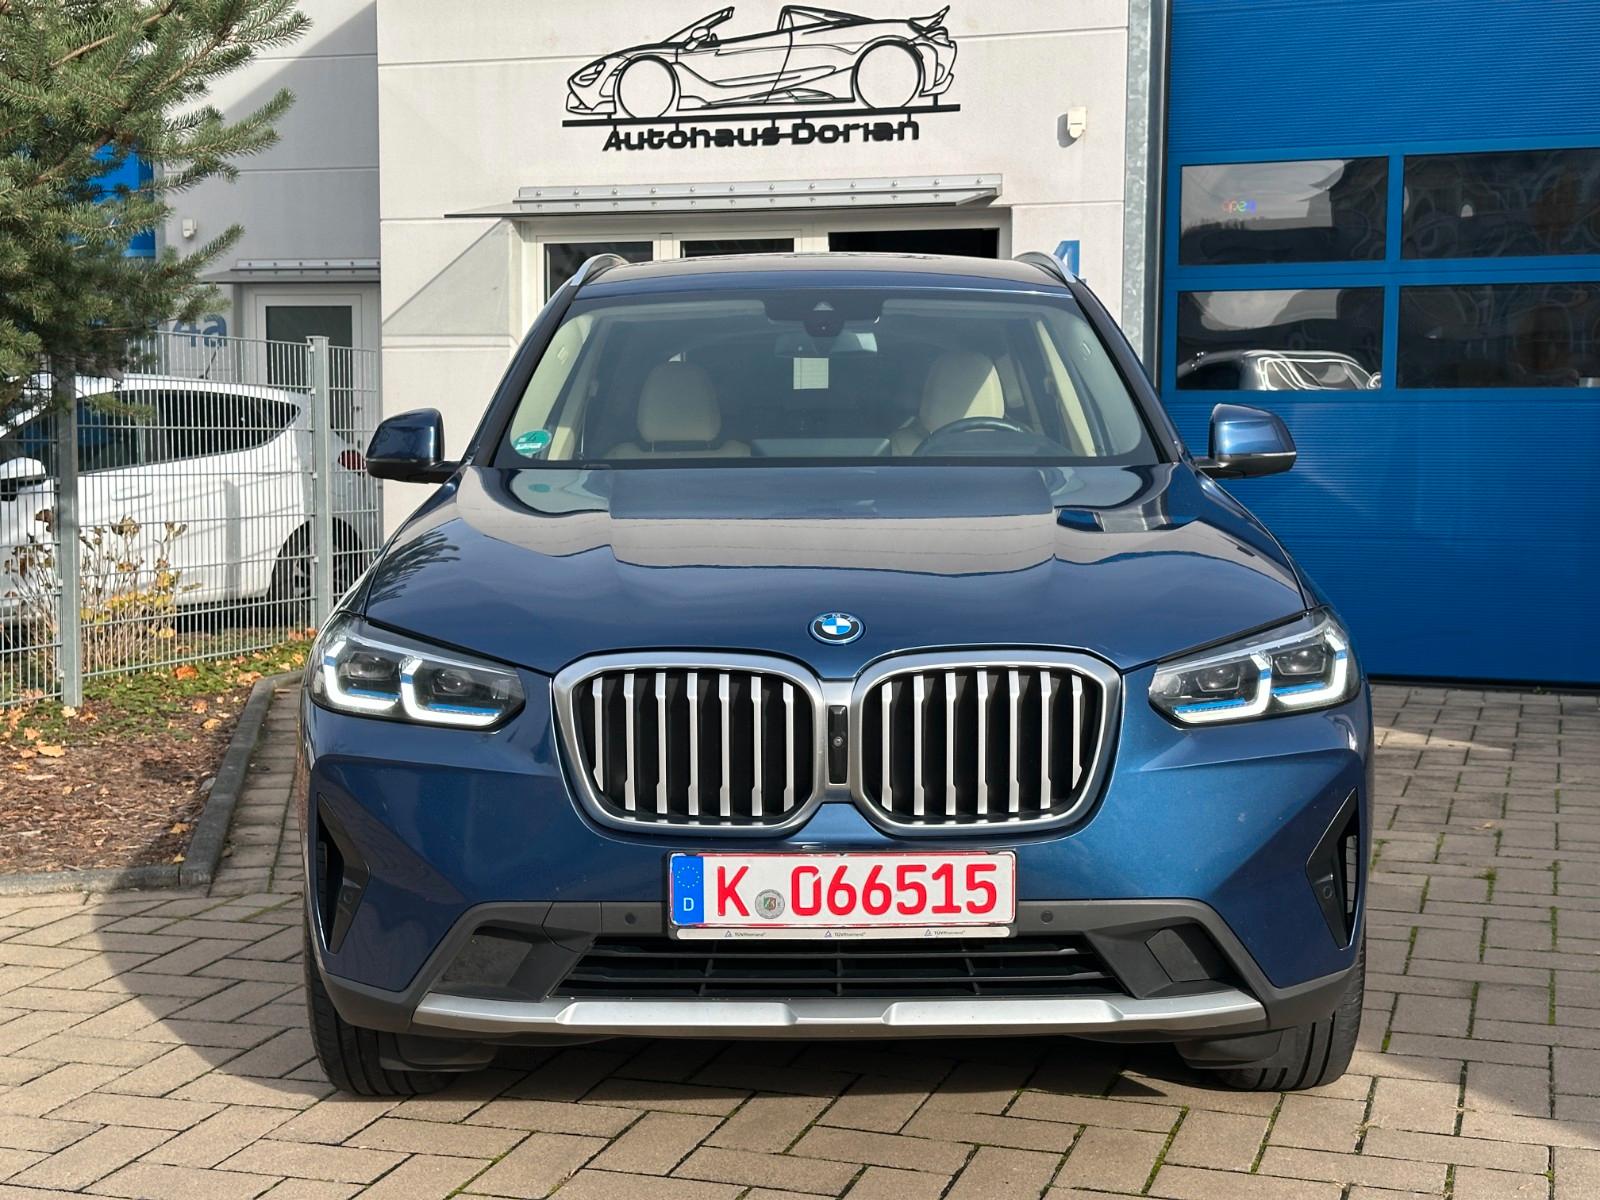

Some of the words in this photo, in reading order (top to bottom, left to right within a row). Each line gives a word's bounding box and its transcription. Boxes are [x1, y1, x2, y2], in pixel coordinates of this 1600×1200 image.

[603, 126, 780, 151] Autohaus
[792, 121, 919, 145] Dorian
[683, 897, 694, 911] D
[717, 866, 750, 917] K
[791, 863, 998, 917] 066515
